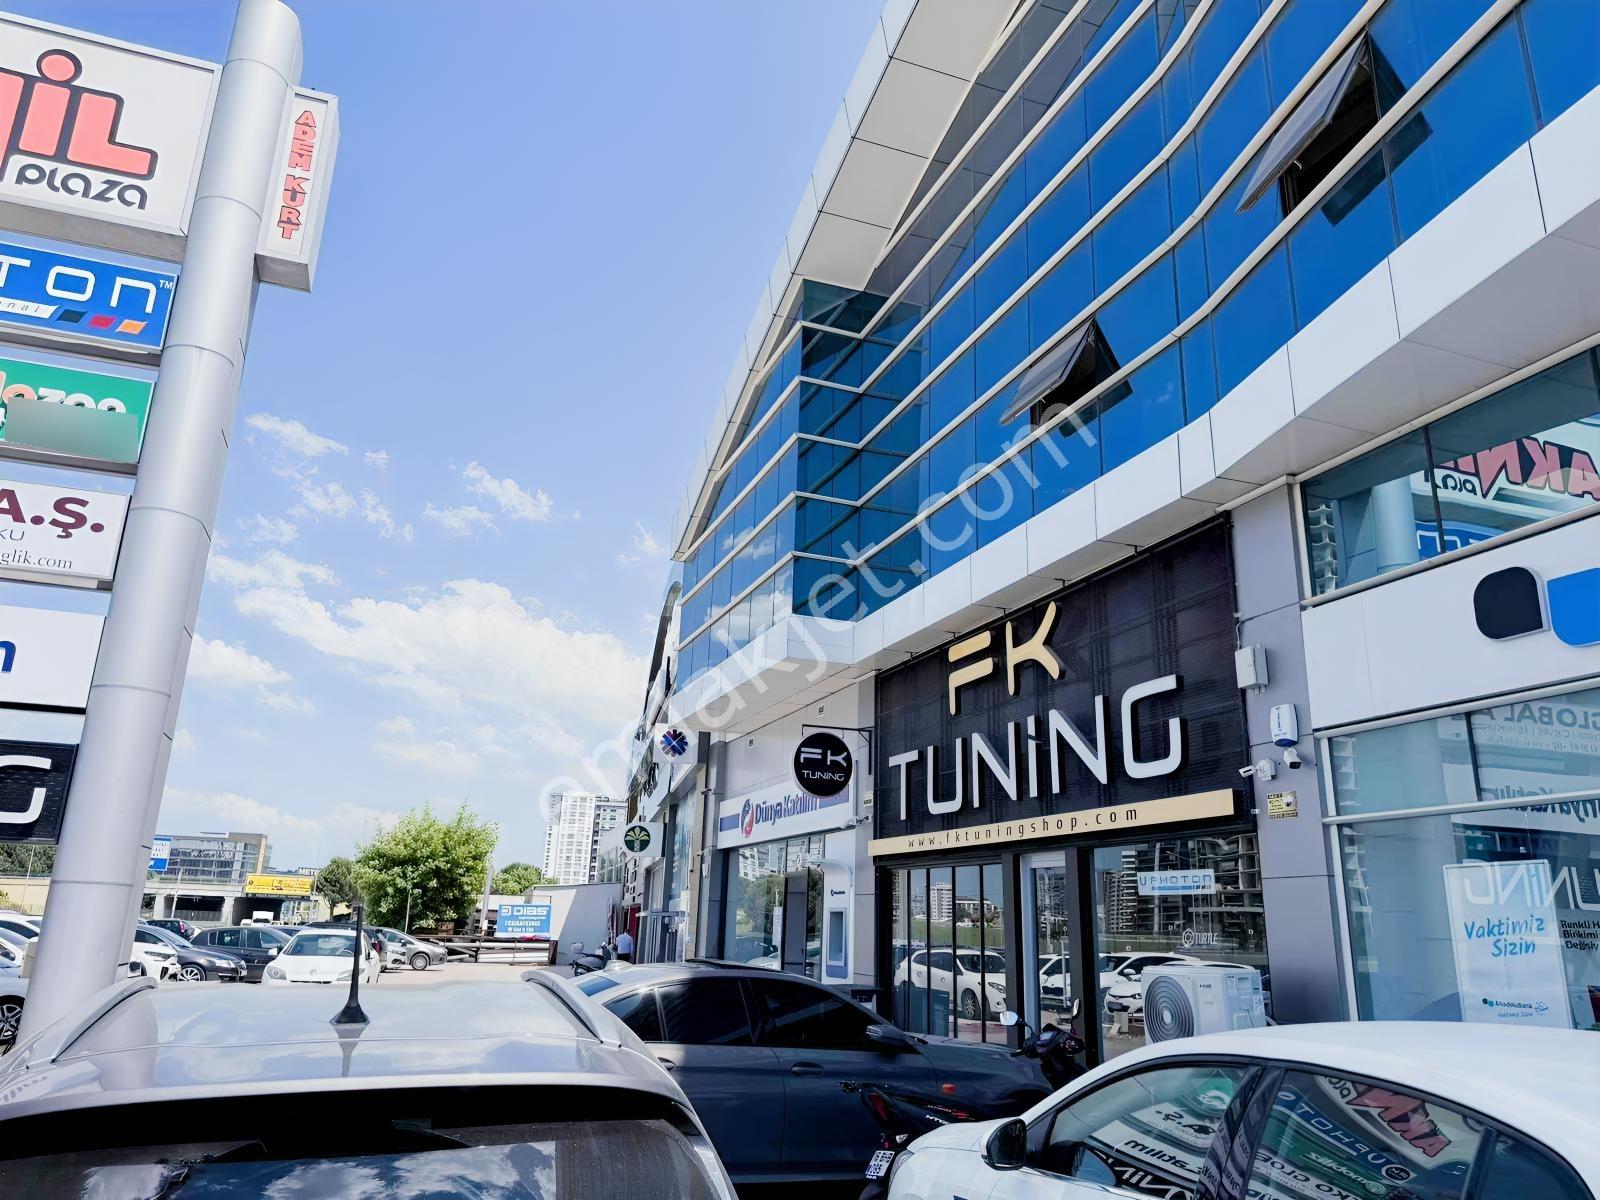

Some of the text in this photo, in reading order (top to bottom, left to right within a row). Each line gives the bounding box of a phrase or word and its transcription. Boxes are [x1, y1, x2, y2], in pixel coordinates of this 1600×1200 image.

[15, 163, 148, 211] plaza
[277, 110, 316, 240] ADEM KURT
[947, 601, 1063, 716] FK
[800, 747, 847, 768] FK
[755, 800, 782, 826] Dünya
[907, 806, 1139, 848] www.fktuningshop.com
[1139, 874, 1212, 887] UPHOTON
[1193, 932, 1218, 945] TURTLE
[1464, 914, 1545, 940] Vaktimiz
[1491, 938, 1536, 957] Sizin
